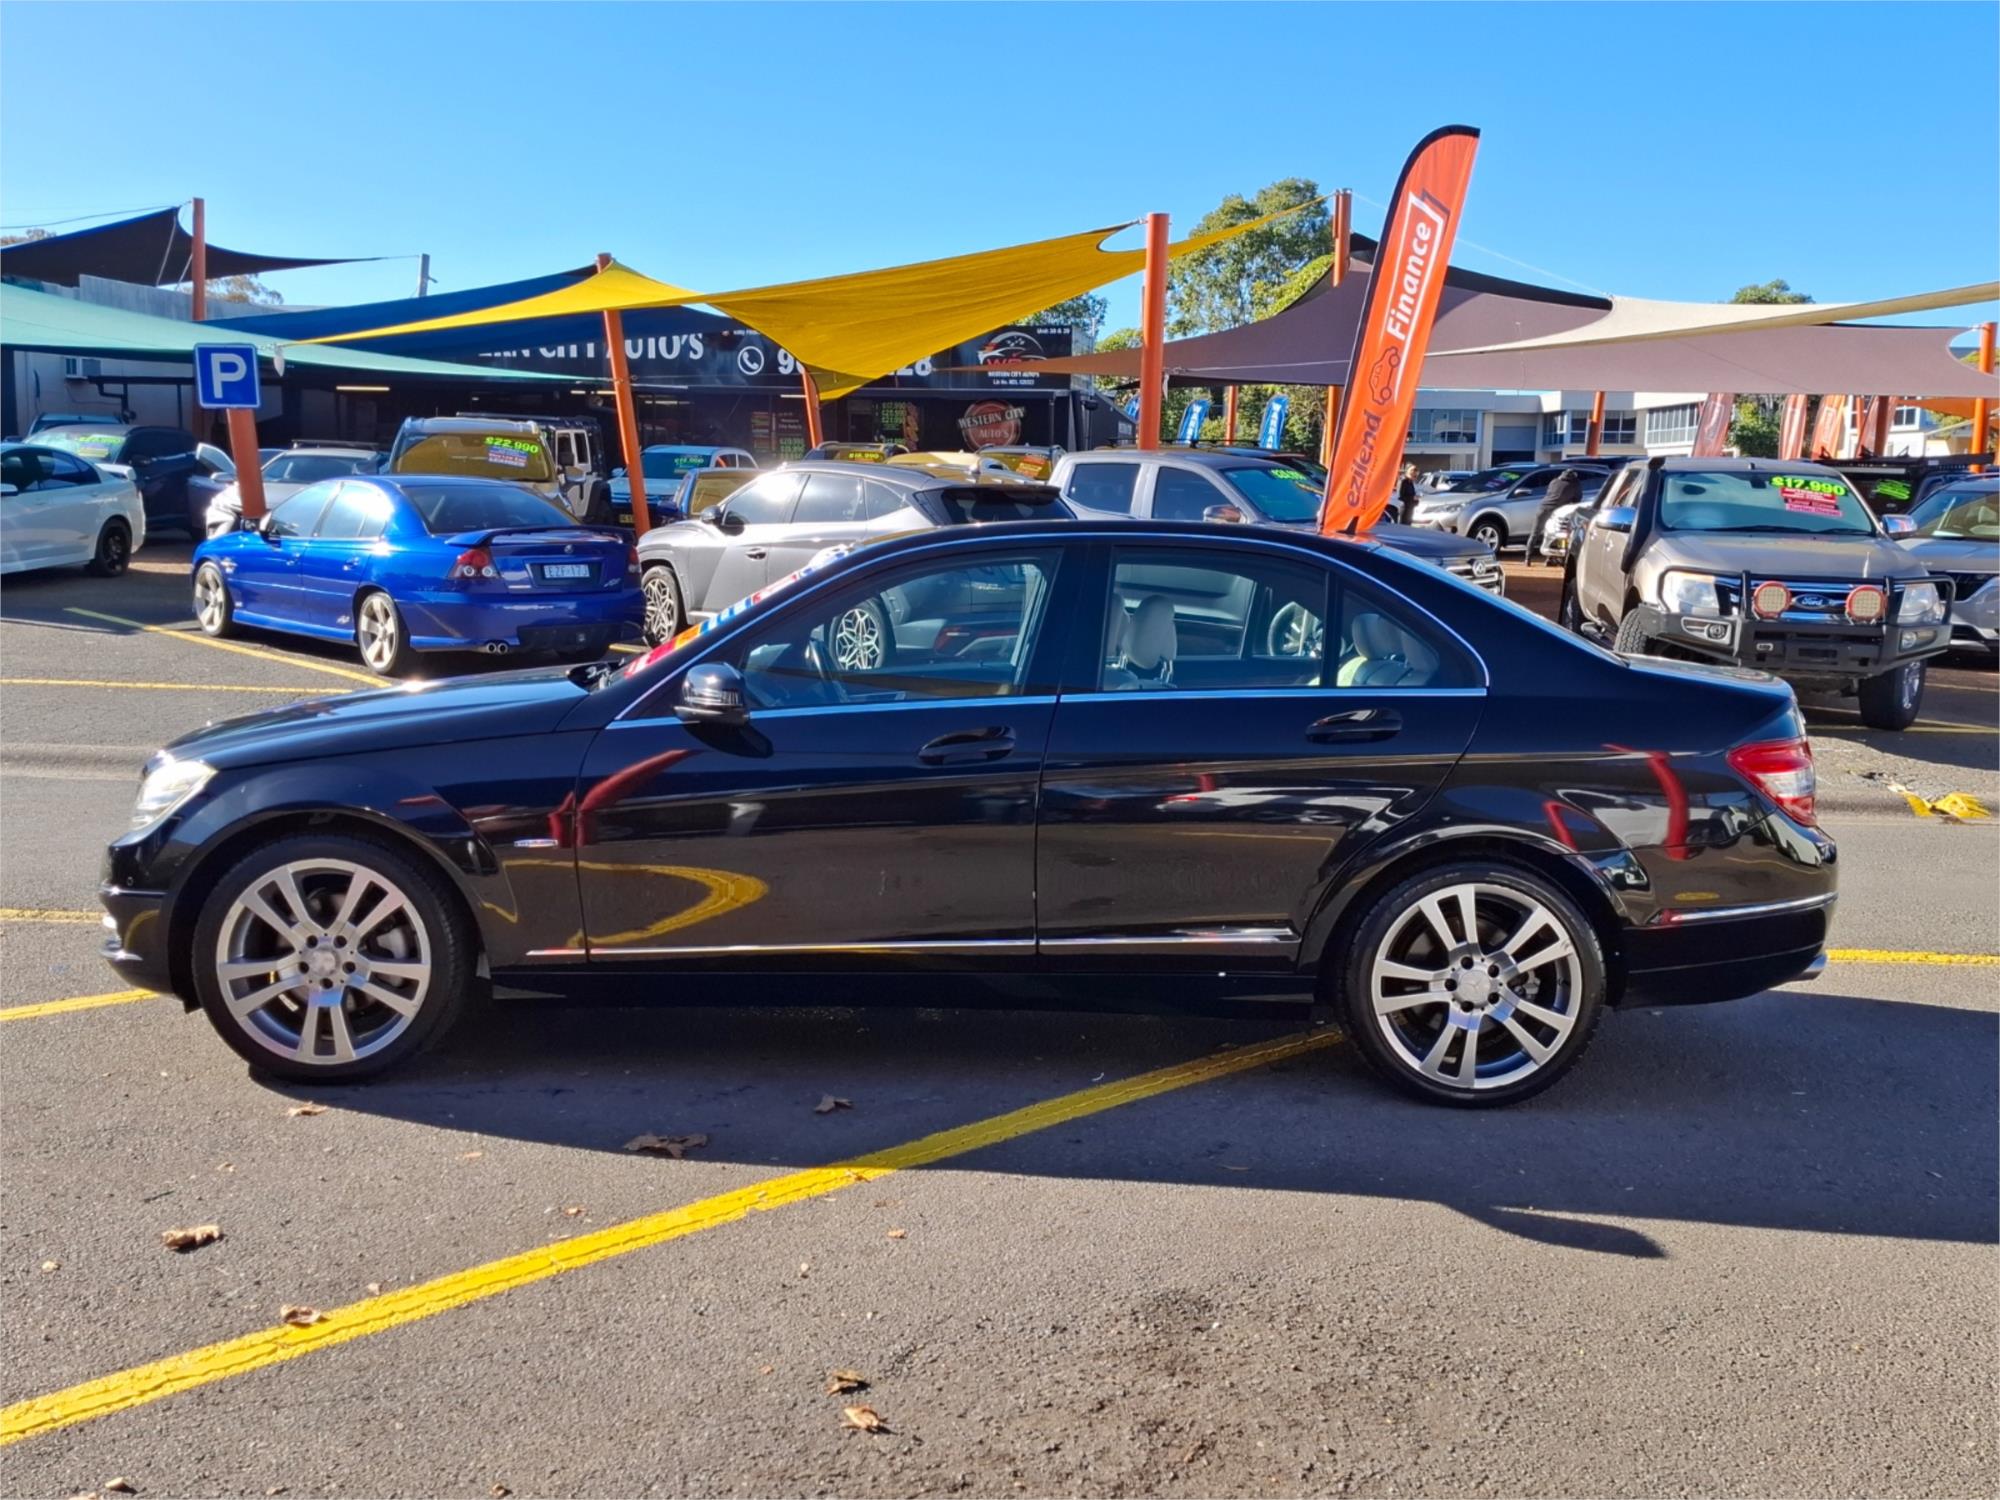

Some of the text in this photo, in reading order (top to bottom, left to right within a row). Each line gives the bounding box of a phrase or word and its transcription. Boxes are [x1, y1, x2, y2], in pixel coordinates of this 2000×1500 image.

[1386, 222, 1432, 341] Finance
[210, 353, 247, 399] P
[958, 406, 1025, 429] WESTERN CITY
[979, 428, 1010, 439] AUTO'S
[1346, 408, 1382, 508] ezilend
